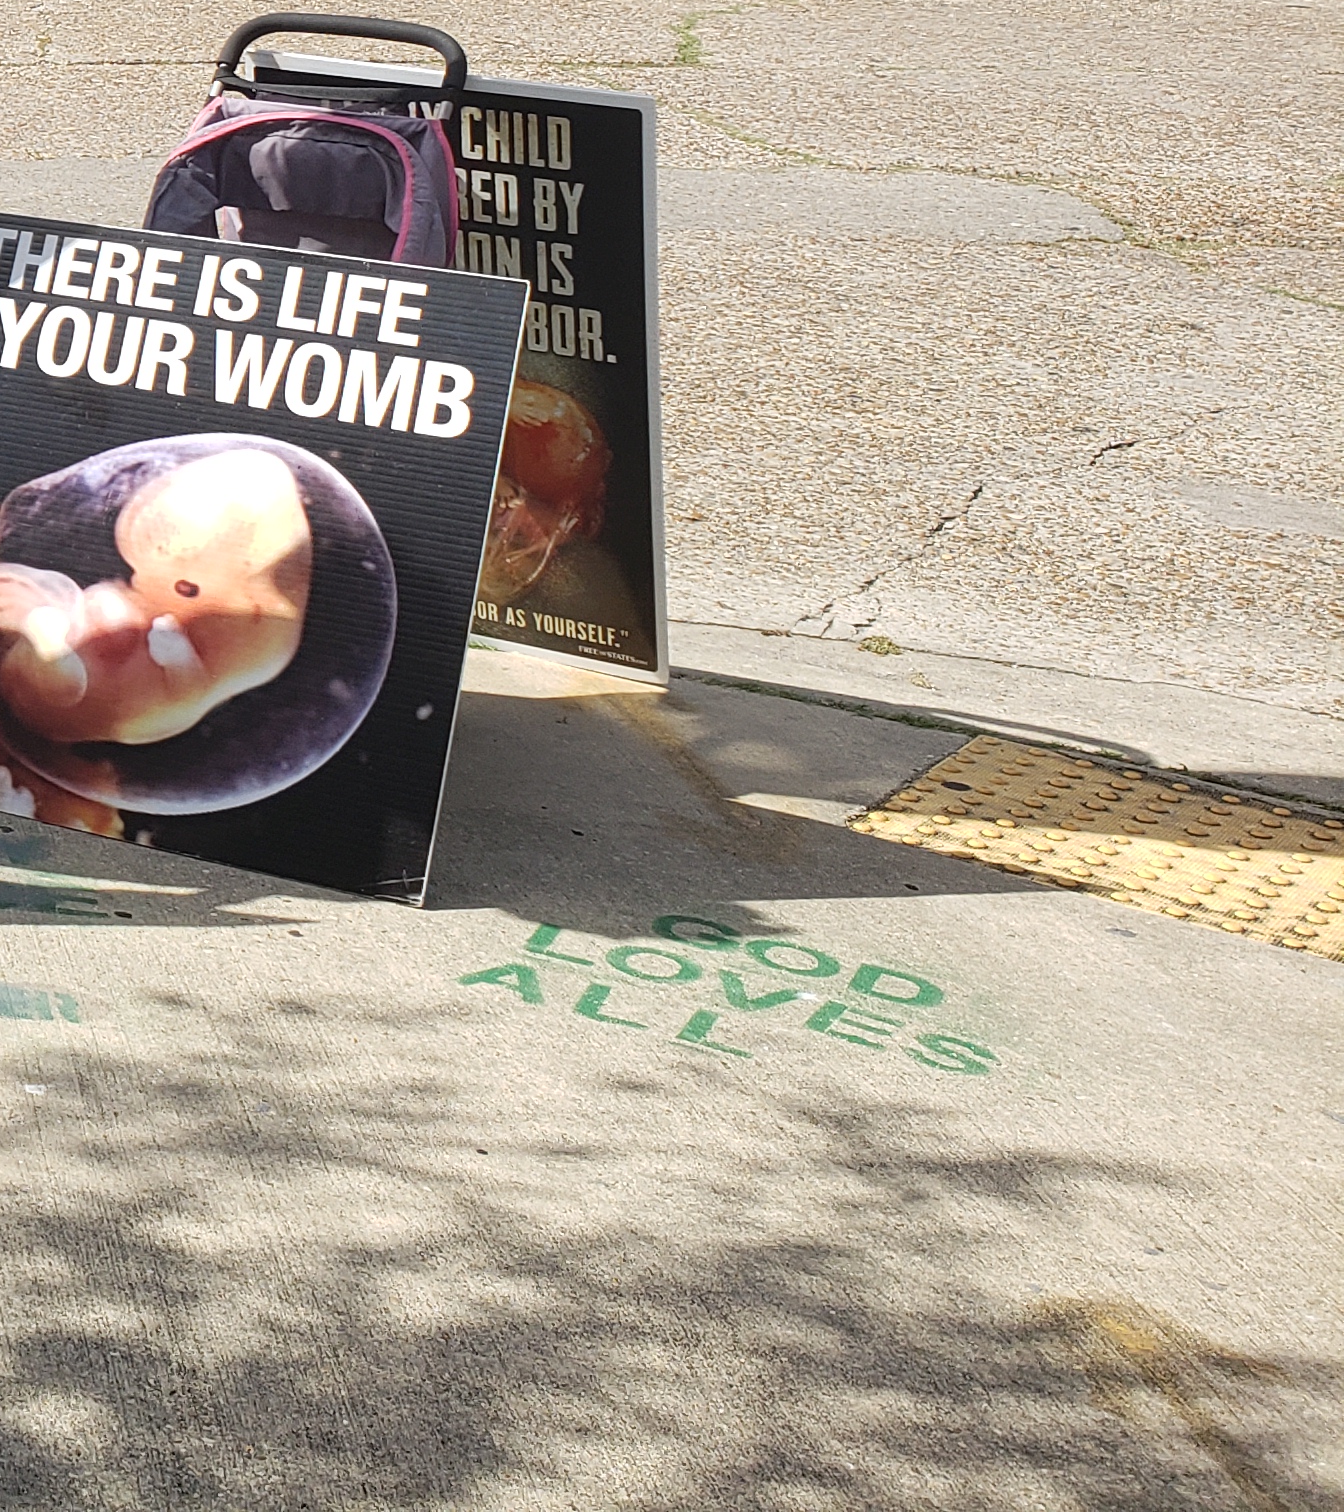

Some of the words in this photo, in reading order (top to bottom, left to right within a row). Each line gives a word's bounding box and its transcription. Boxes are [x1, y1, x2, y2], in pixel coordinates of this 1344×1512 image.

[461, 106, 571, 171] CHILD
[454, 167, 518, 226] RED
[533, 177, 584, 234] BY
[193, 255, 262, 321] IS
[276, 266, 427, 348] LIFE
[455, 229, 522, 278] ION
[536, 240, 574, 296] IS
[527, 300, 617, 363] BOR.
[214, 331, 475, 439] WOMB
[473, 601, 498, 622] OR
[505, 606, 526, 628] AS
[524, 924, 1002, 1076] LOVES
[651, 914, 944, 1007] GOD
[457, 963, 753, 1059] ALL
